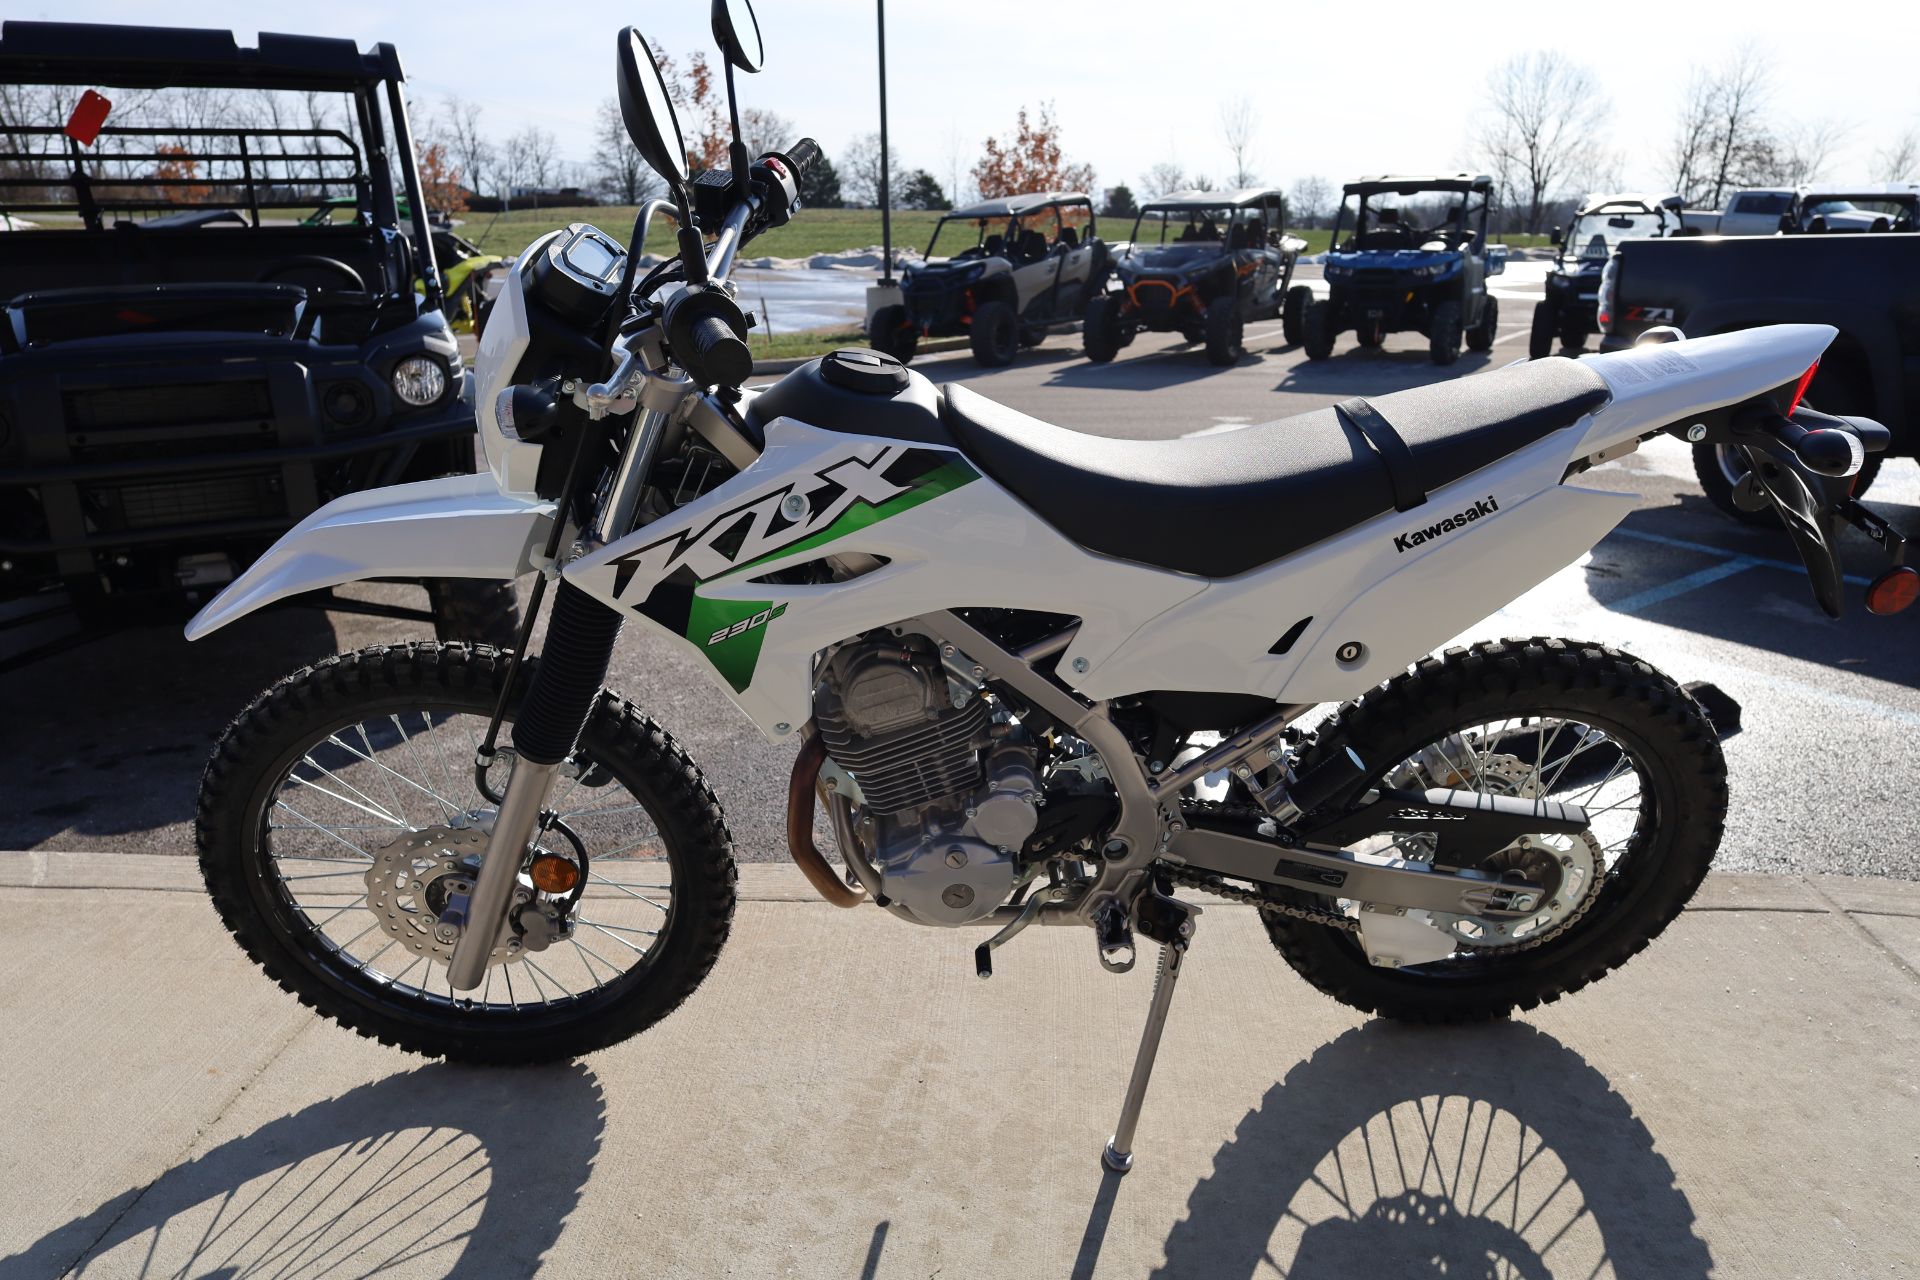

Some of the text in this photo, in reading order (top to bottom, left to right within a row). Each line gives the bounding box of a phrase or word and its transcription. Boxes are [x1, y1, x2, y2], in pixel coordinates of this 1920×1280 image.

[1624, 306, 1674, 323] Z71
[604, 445, 914, 607] KLX
[1393, 495, 1499, 553] Kawasaki
[705, 602, 789, 647] 230S
